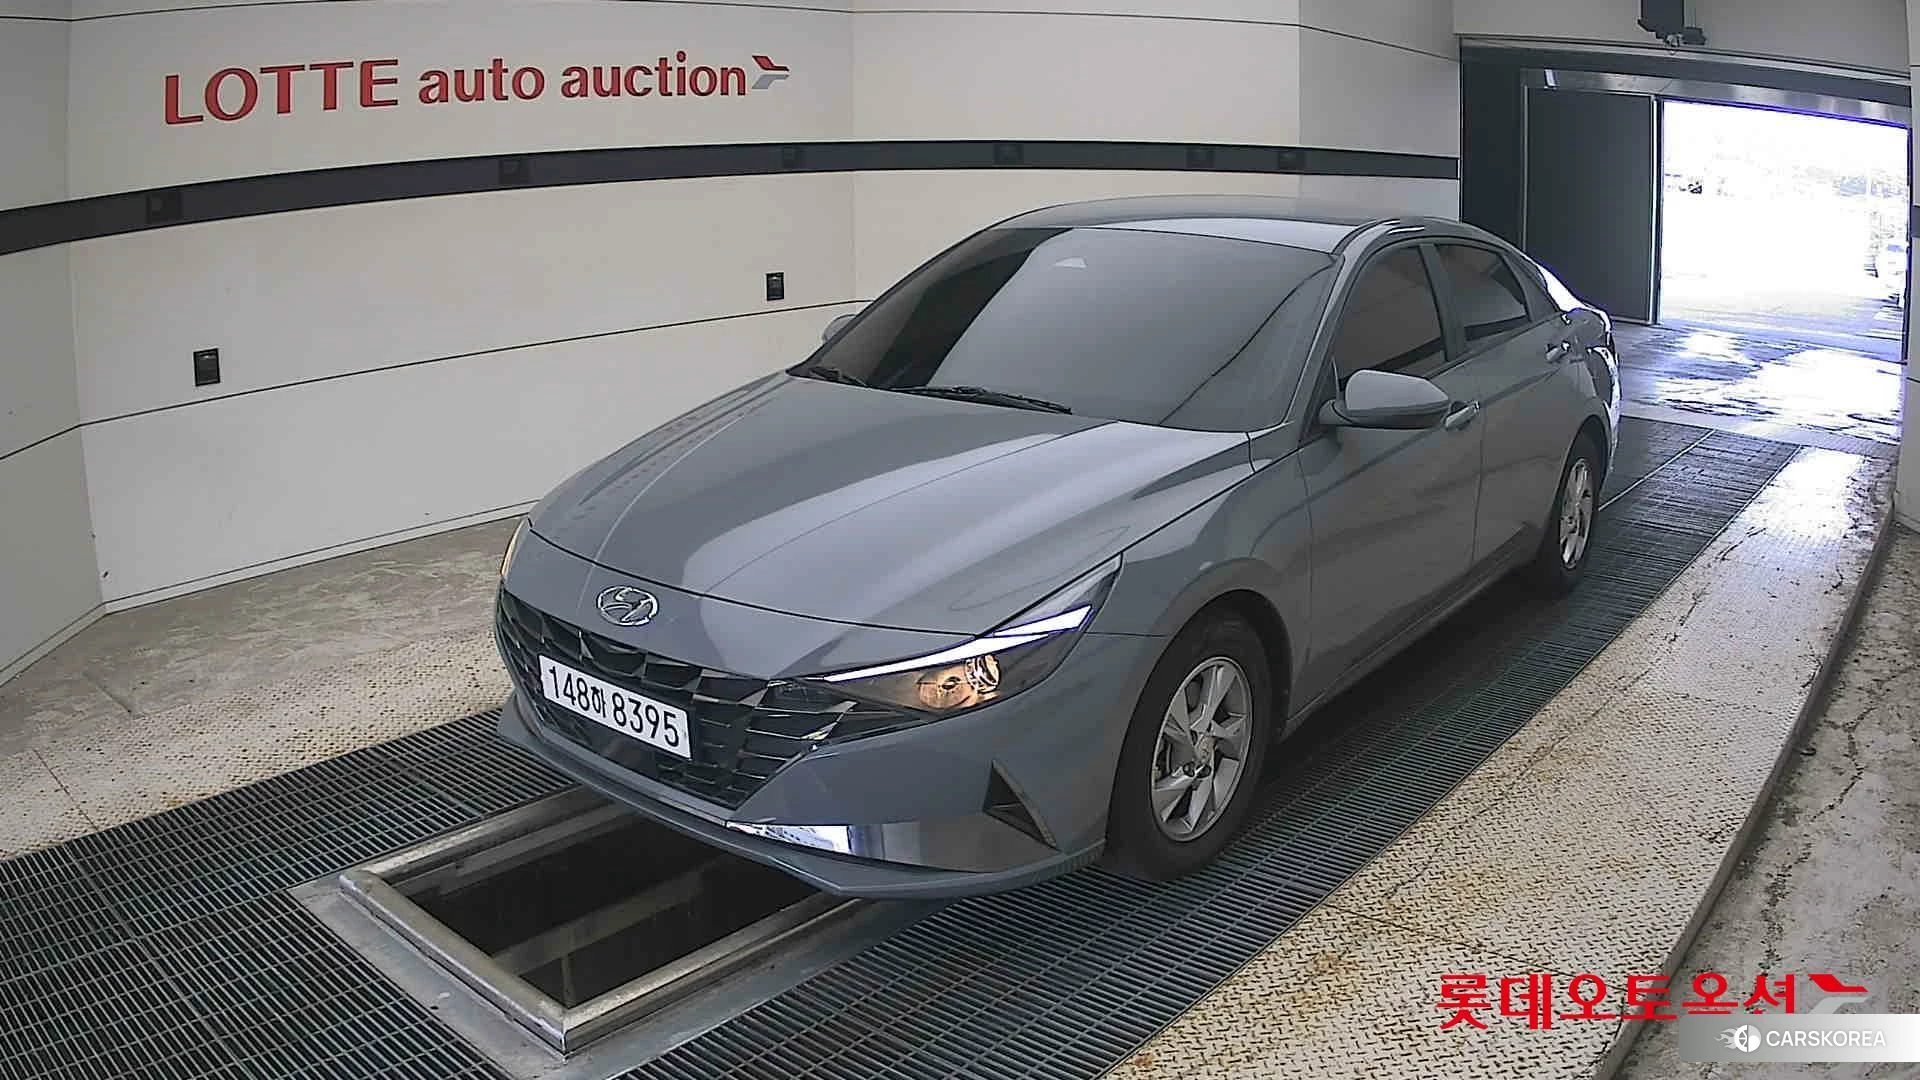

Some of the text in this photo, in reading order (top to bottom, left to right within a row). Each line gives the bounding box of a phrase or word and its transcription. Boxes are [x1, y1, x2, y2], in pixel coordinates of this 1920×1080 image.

[164, 50, 747, 125] LOTTE auto auction
[549, 665, 680, 748] 148하 8395
